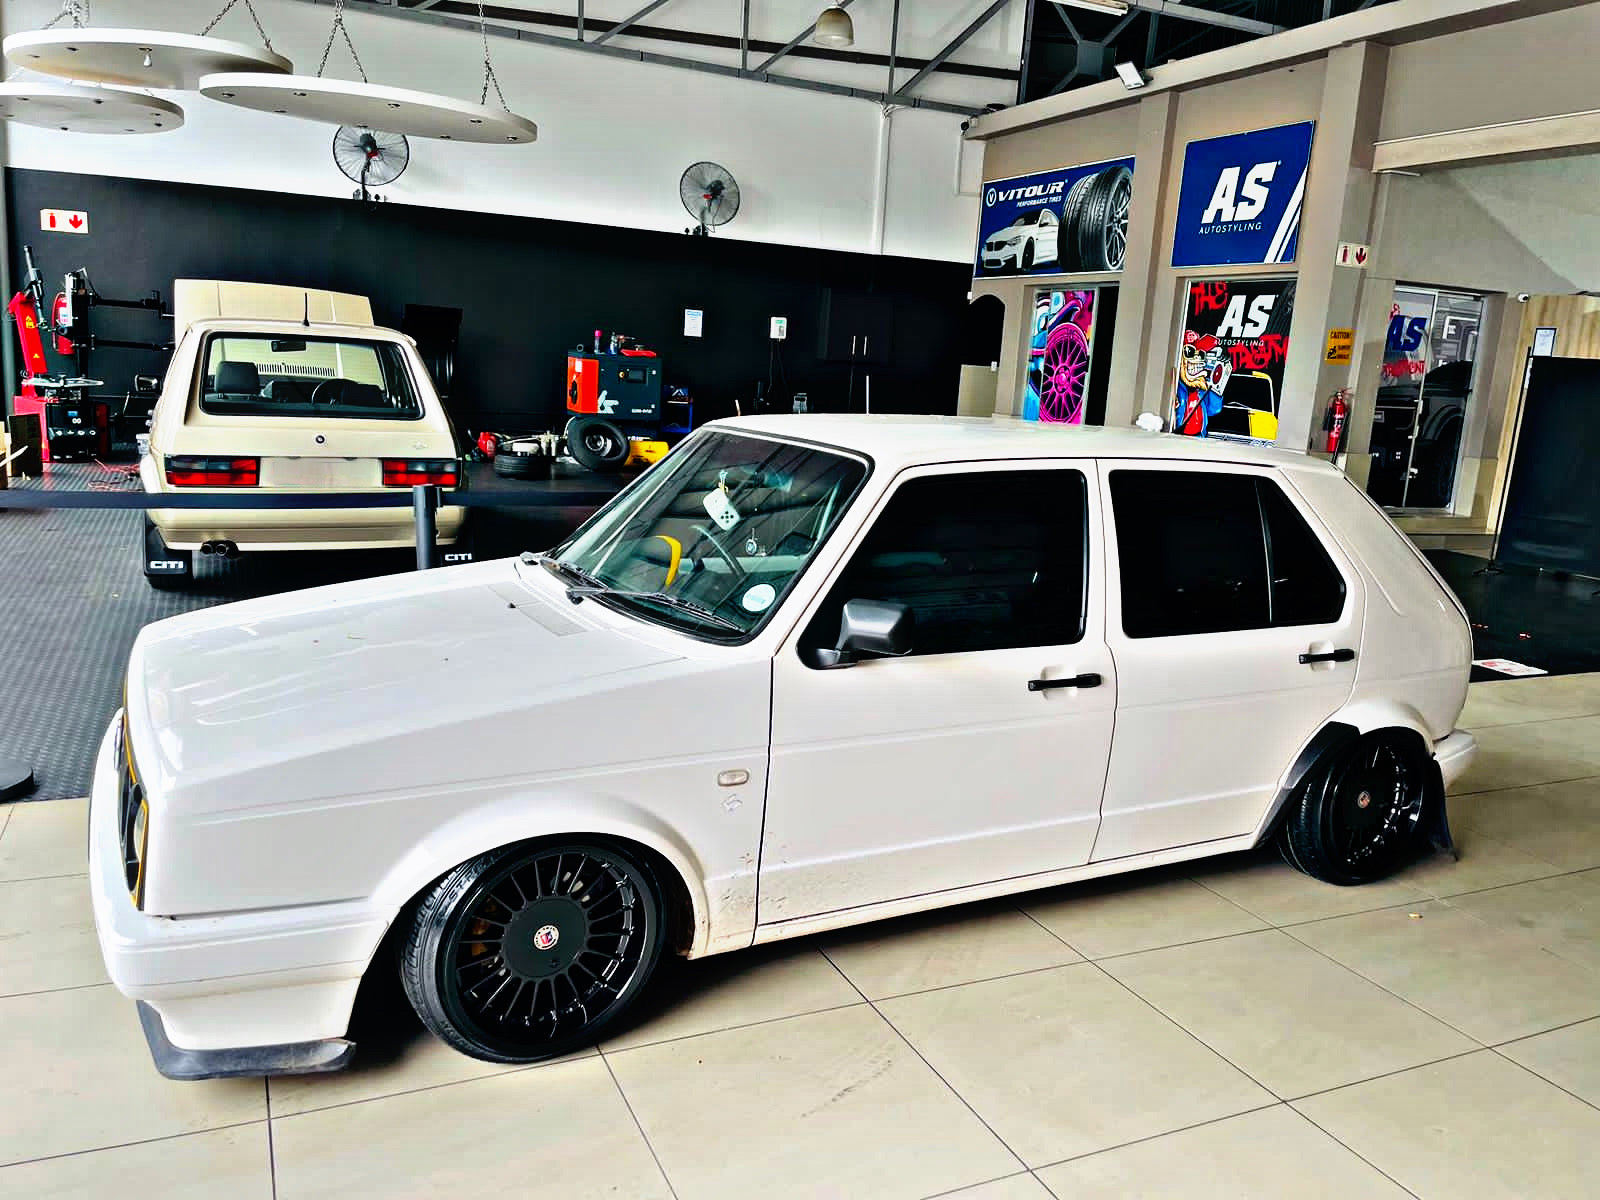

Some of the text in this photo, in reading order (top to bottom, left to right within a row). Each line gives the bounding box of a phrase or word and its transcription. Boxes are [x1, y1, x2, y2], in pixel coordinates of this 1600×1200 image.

[998, 181, 1065, 202] VITOUR
[1201, 161, 1278, 224] AS
[1199, 222, 1262, 235] AUTOSTYLING
[1216, 294, 1276, 338] AS
[1385, 314, 1428, 352] AS
[1214, 339, 1265, 347] AUTOSTYLING
[150, 560, 184, 569] CITI
[445, 552, 472, 561] CITI
